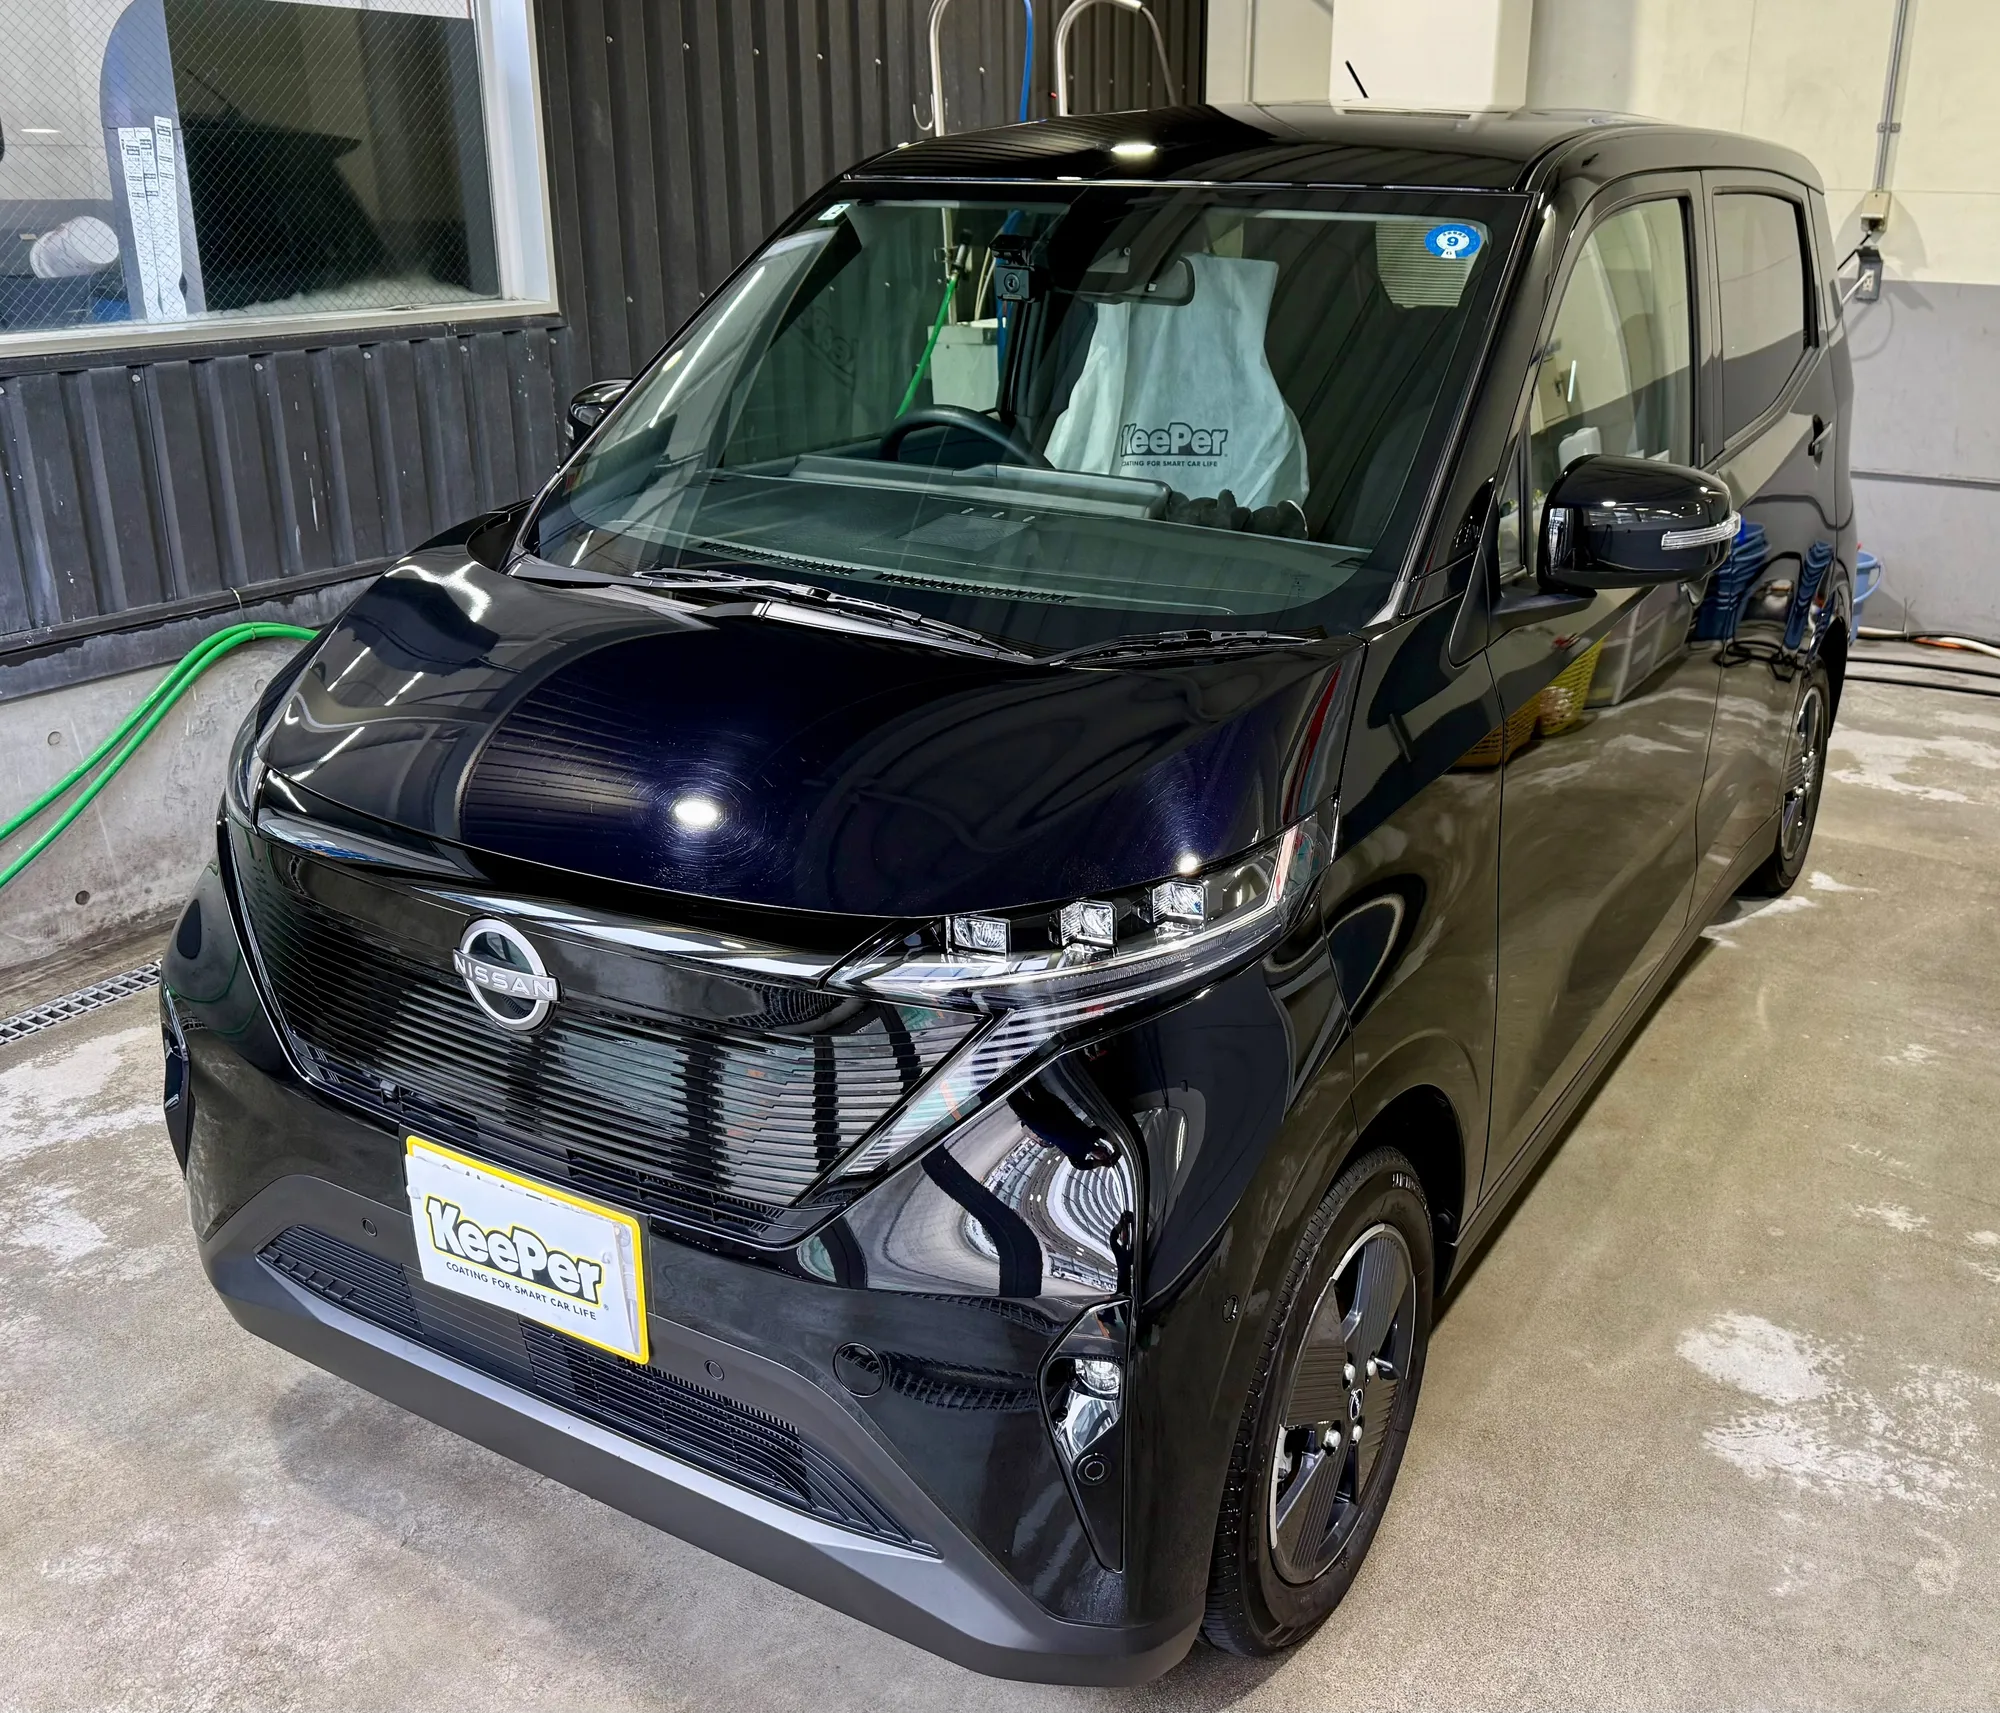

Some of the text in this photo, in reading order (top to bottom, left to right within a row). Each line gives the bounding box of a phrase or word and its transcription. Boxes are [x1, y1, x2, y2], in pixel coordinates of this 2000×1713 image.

[1447, 236, 1459, 247] 9
[1120, 422, 1229, 457] KeePer
[454, 954, 555, 999] NISSAN
[425, 1195, 604, 1305] KeePer
[446, 1261, 597, 1320] COATING FOR SMART CAR LIFE
